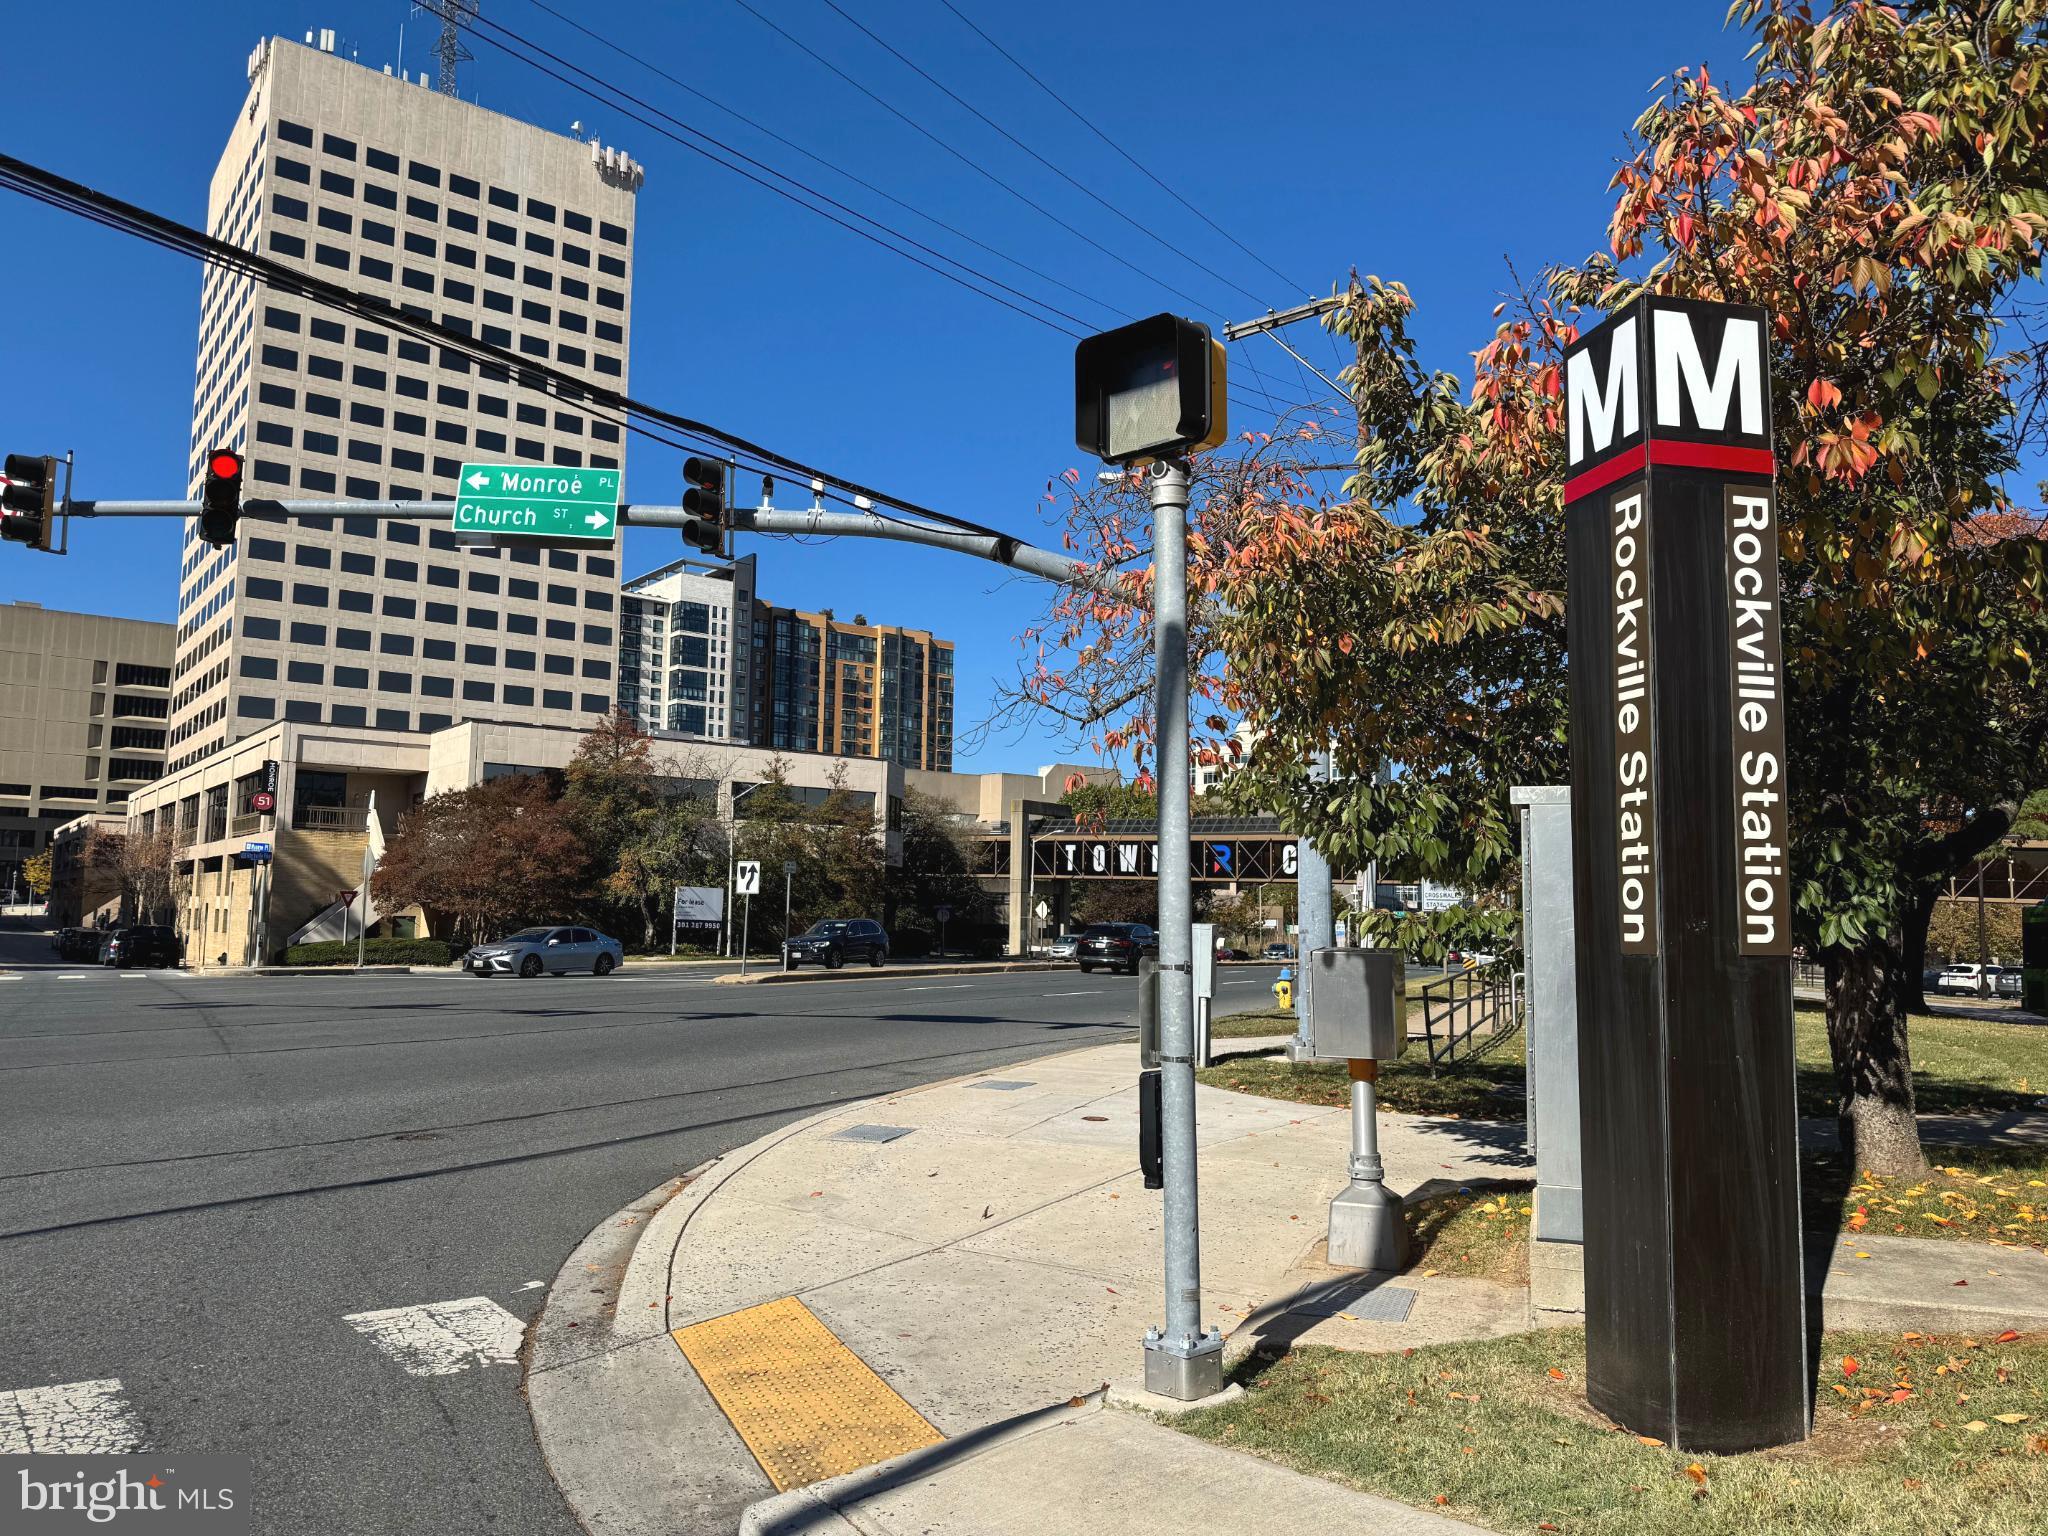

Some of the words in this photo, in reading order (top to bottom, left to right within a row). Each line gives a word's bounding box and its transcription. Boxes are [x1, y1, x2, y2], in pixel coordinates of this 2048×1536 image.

[1567, 316, 1640, 467] M
[1653, 309, 1764, 435] M
[459, 504, 536, 526] Church
[553, 508, 568, 519] ST
[501, 472, 582, 494] Monroe
[600, 477, 614, 488] PL
[1615, 493, 1645, 734] Rockville
[1732, 495, 1775, 733] Rockville
[257, 796, 270, 806] 51
[267, 762, 276, 792] MONROE
[689, 898, 705, 906] lease
[1619, 750, 1650, 943] Station
[1740, 750, 1782, 944] Station
